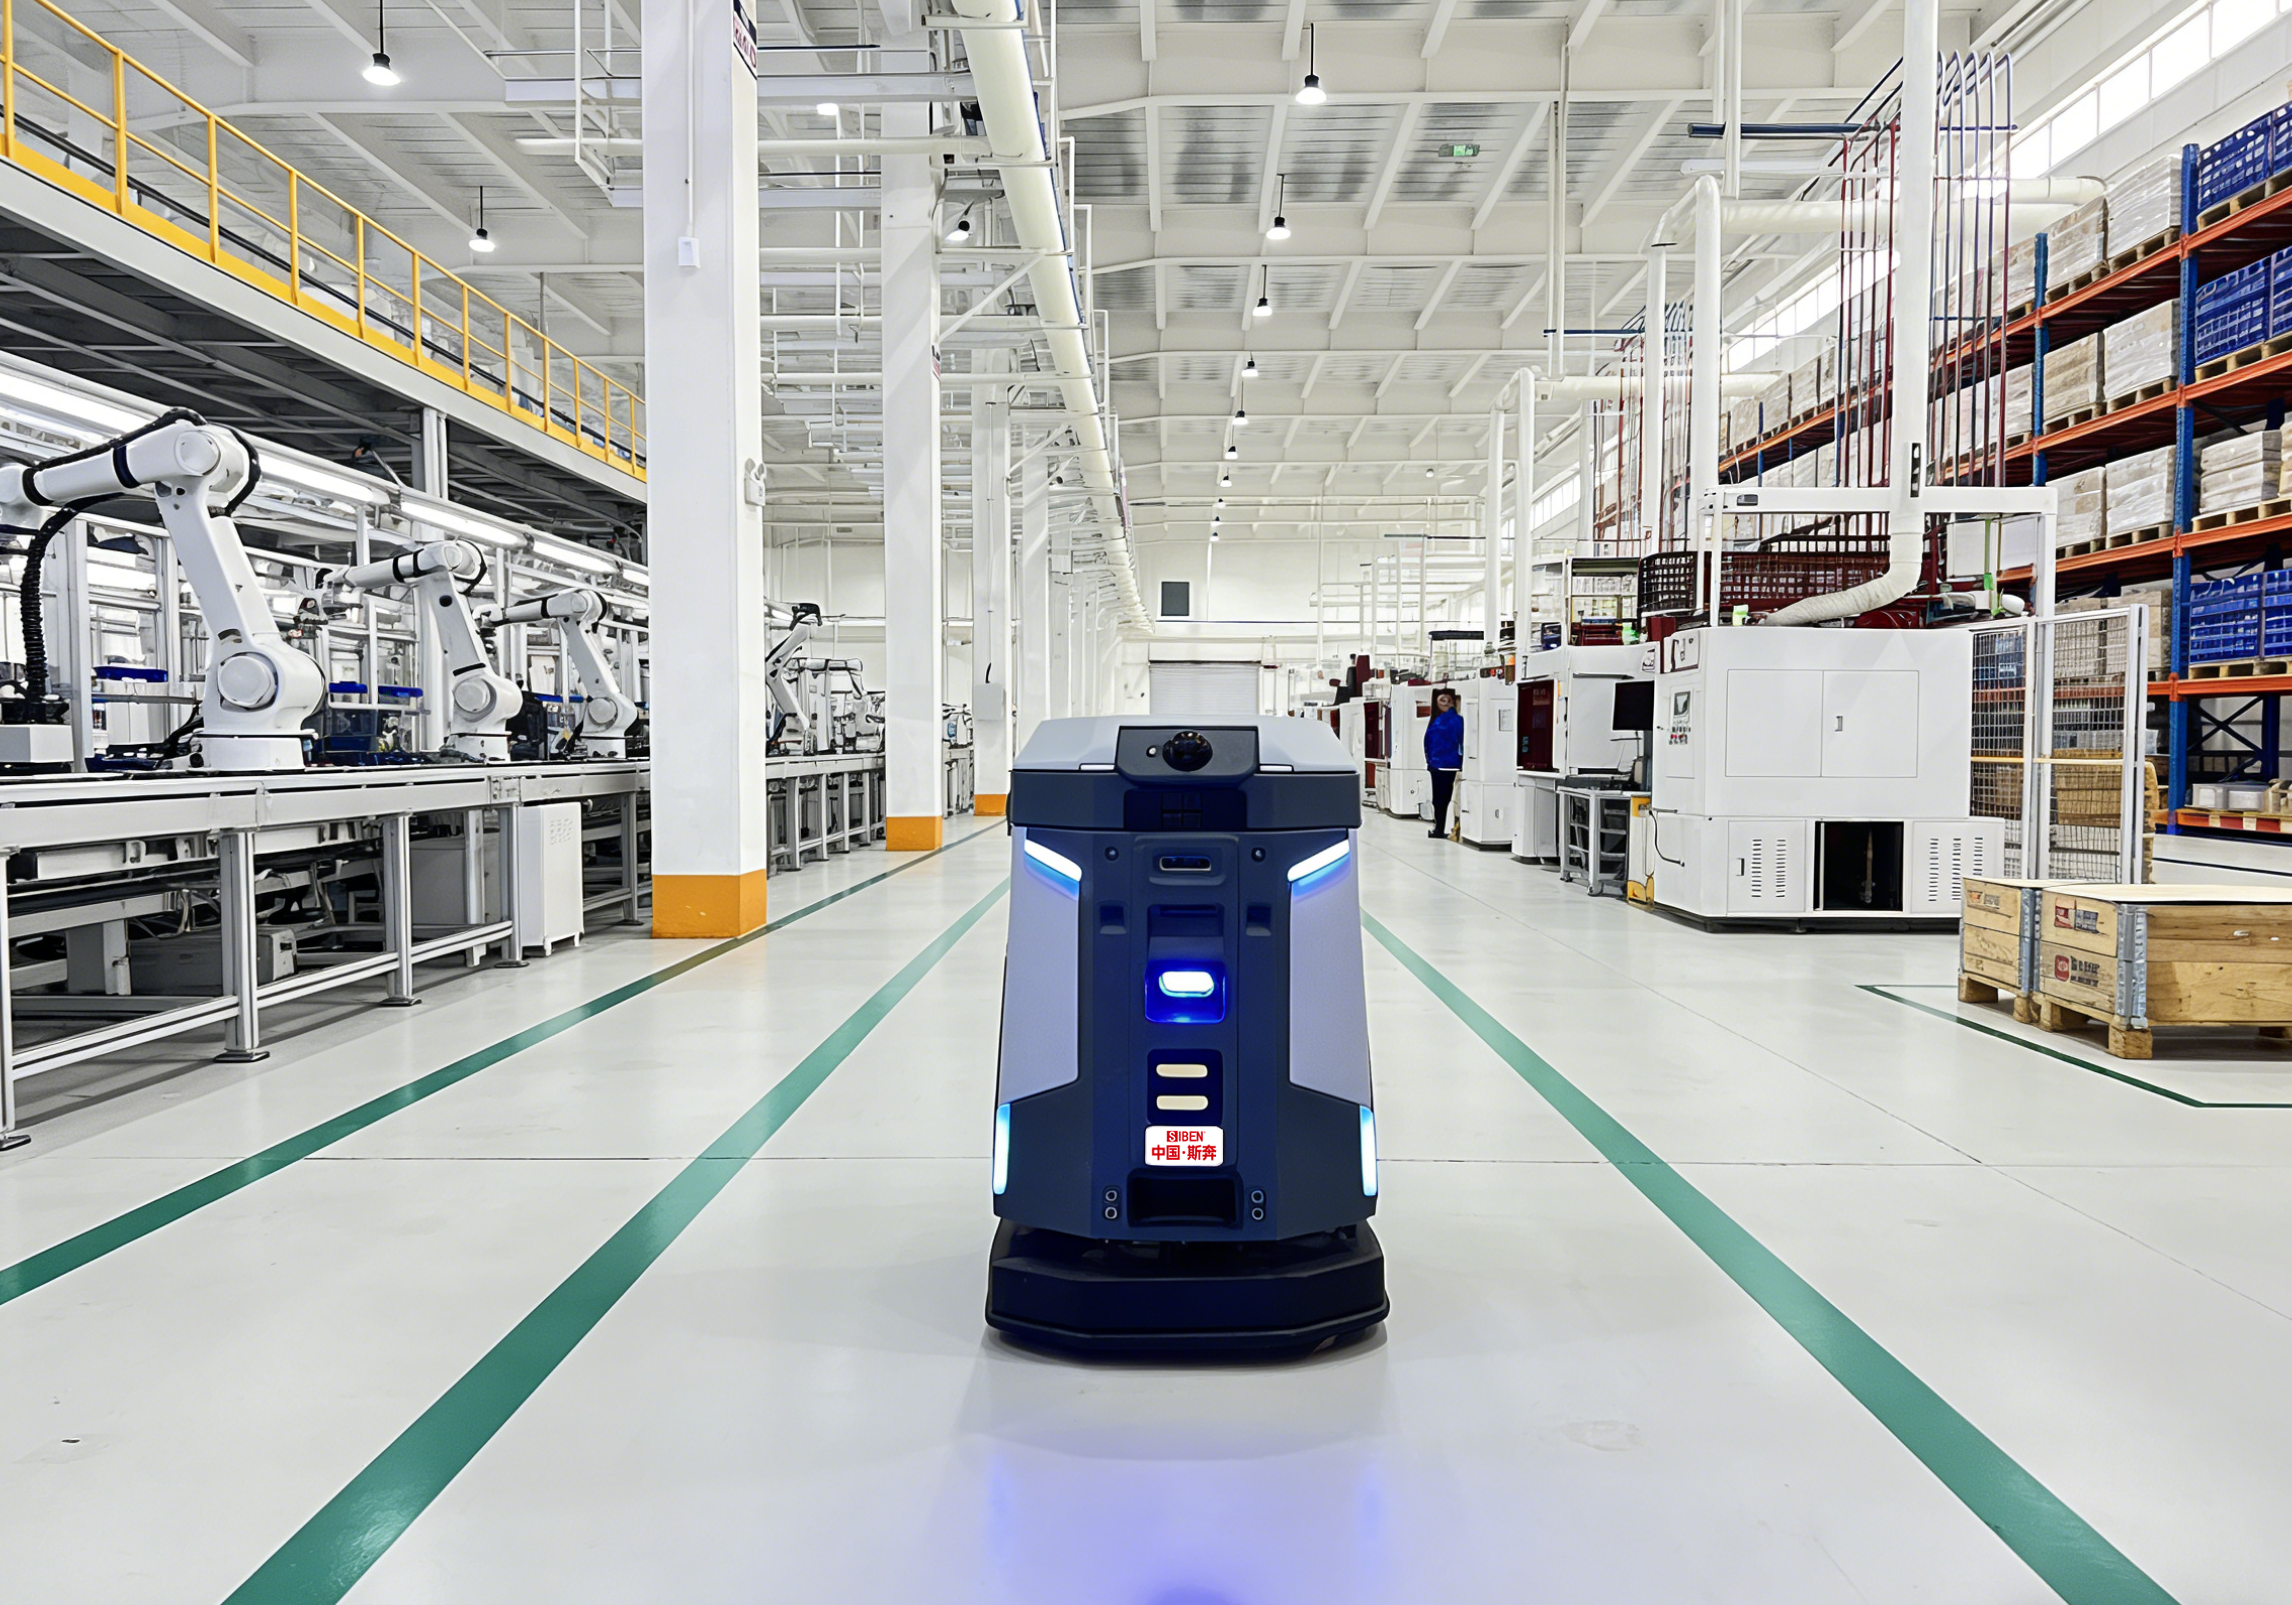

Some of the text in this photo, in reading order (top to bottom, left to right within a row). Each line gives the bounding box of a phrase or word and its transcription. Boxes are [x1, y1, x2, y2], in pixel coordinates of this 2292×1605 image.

[1166, 1131, 1204, 1142] SIBEN
[1151, 1144, 1217, 1161] 中国·斯奔
